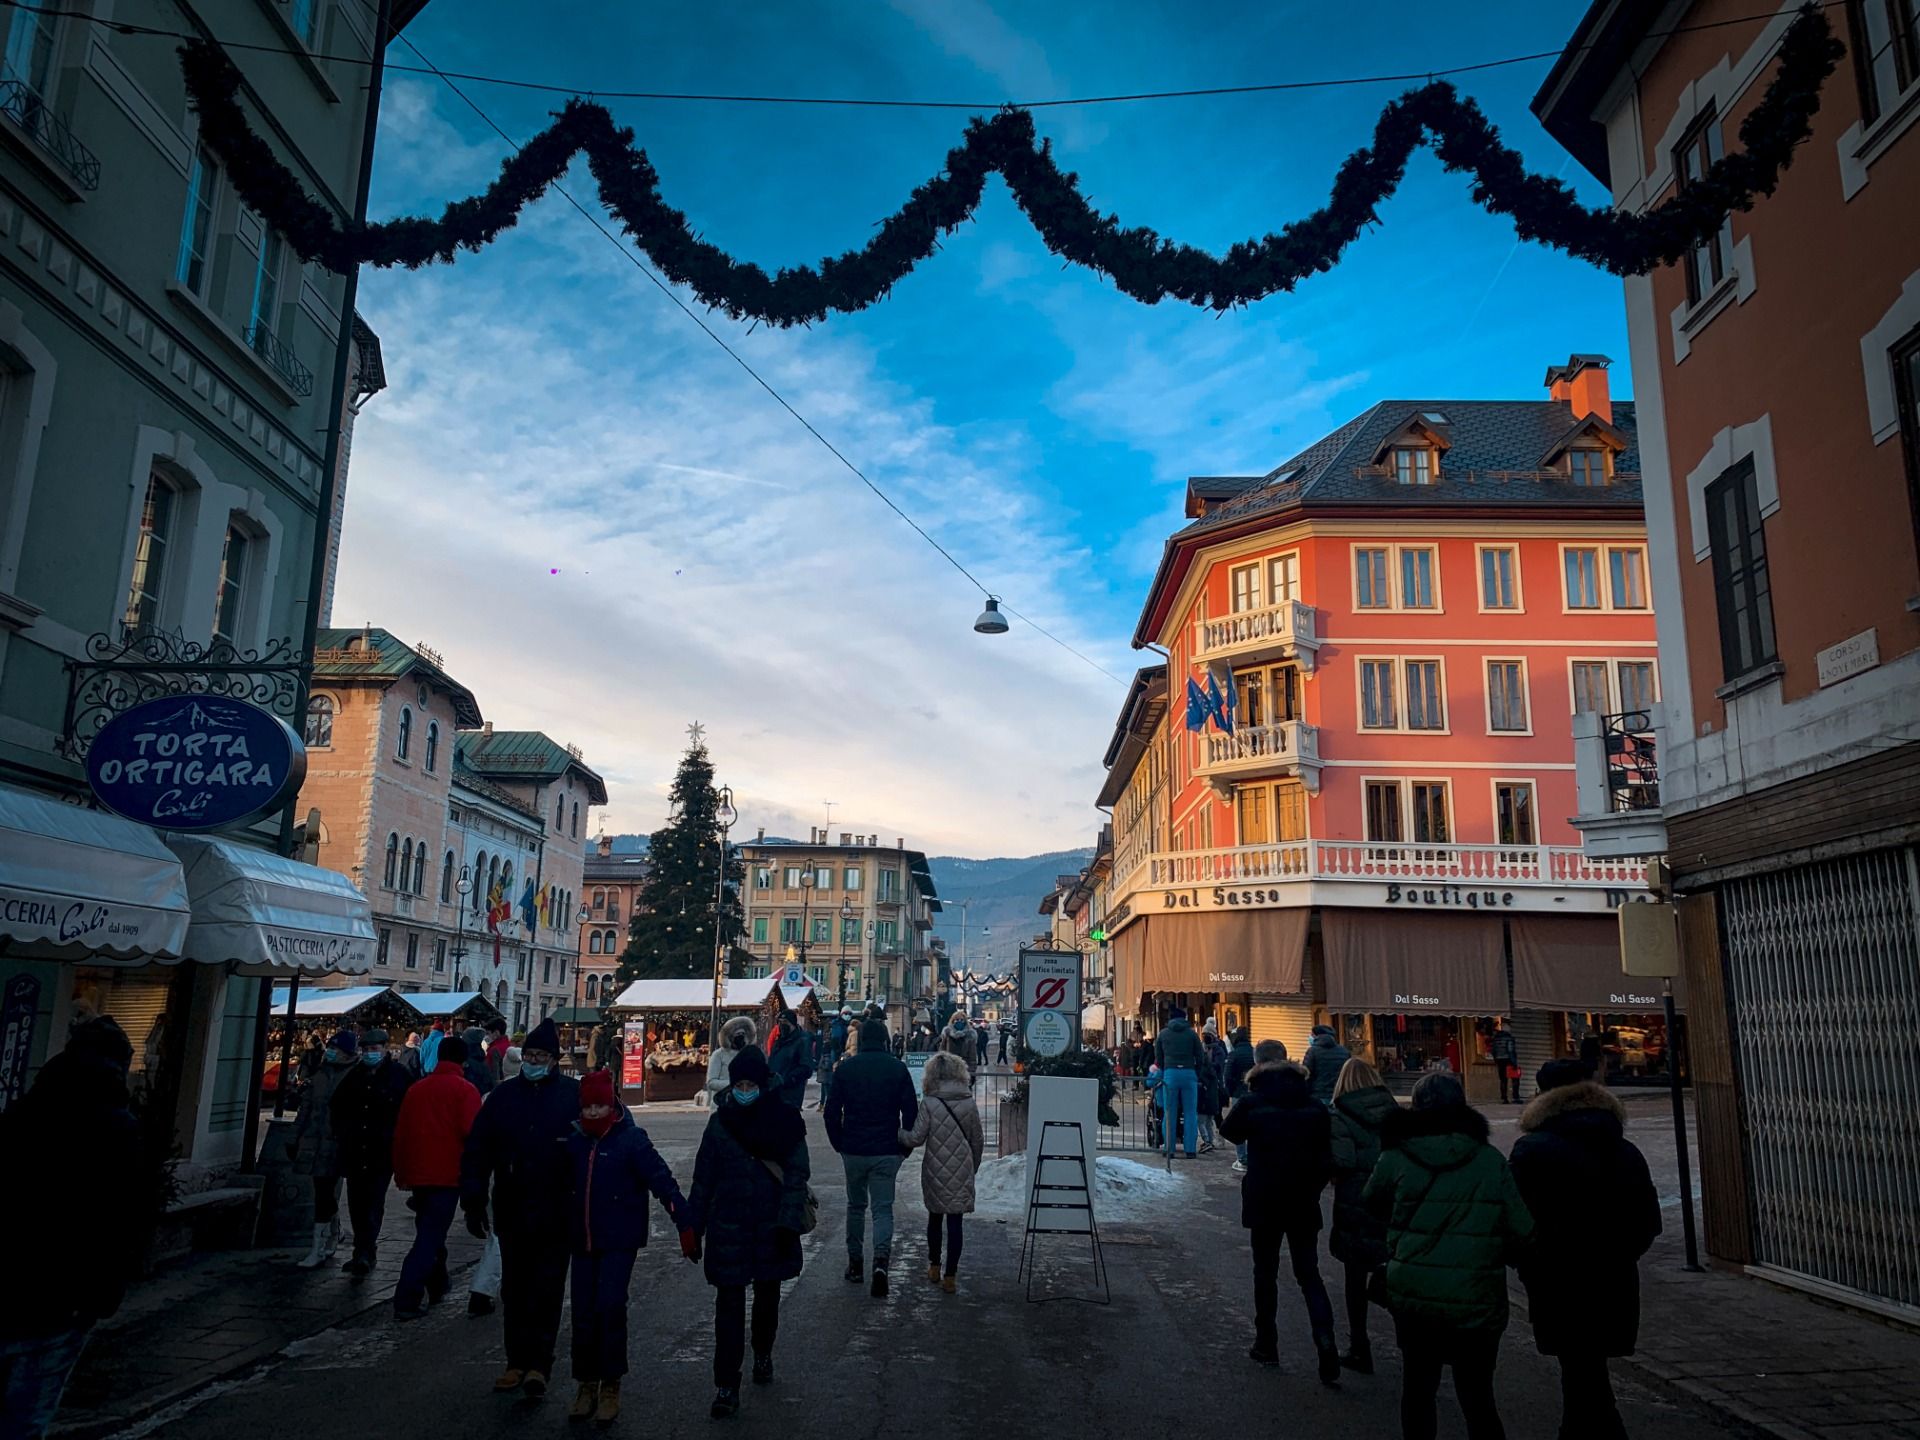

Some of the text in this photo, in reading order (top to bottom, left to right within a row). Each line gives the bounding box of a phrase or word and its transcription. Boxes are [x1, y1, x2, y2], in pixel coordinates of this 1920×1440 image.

[1829, 641, 1861, 662] CORSO
[133, 732, 250, 758] TORTA
[99, 759, 274, 787] ORTIGARA
[152, 788, 213, 818] Carli
[1163, 886, 1280, 908] Dal Sasso
[1385, 884, 1514, 908] Boutique
[59, 902, 109, 941] Carli
[108, 922, 120, 934] dal
[122, 924, 139, 936] 1909
[267, 934, 325, 956] PASTICCERIA
[1209, 972, 1244, 981] Dal Sasso
[1395, 994, 1439, 1005] Dal Sasso
[1610, 994, 1656, 1004] Dal Sasso
